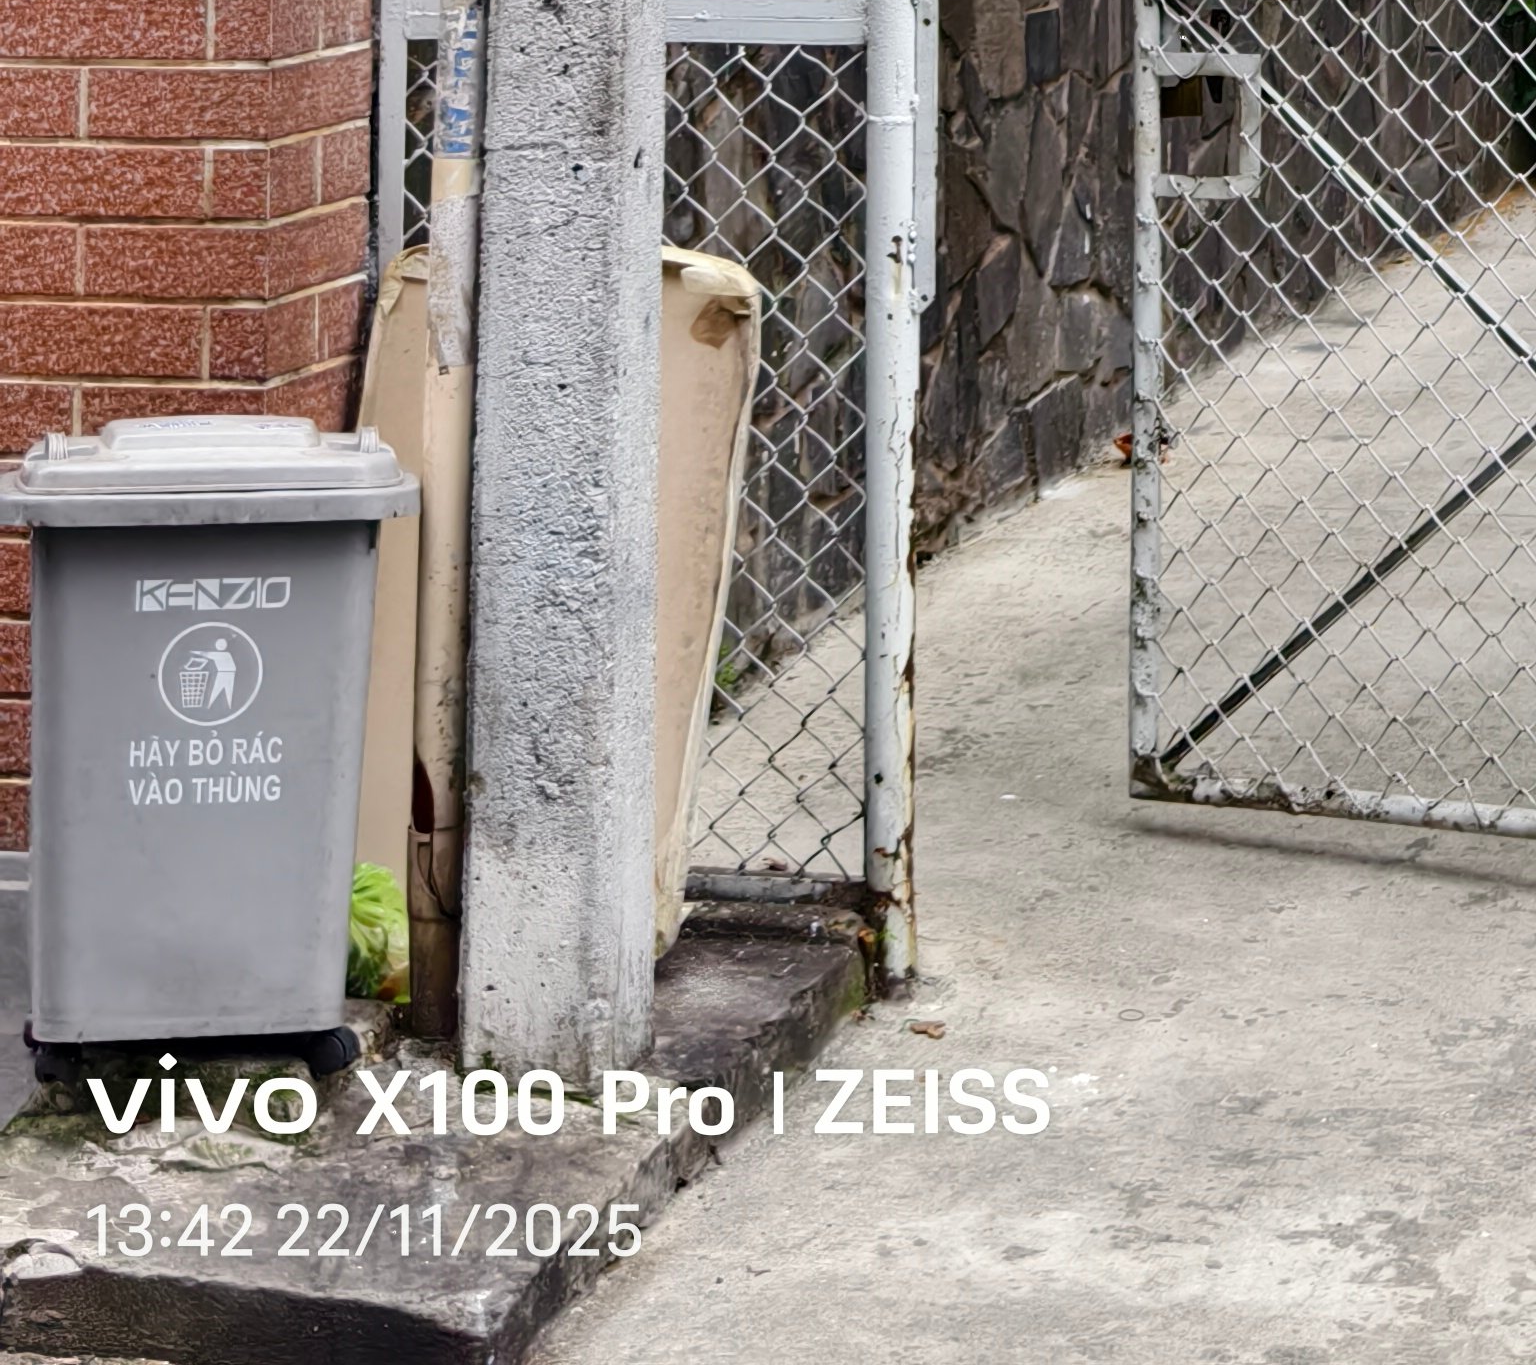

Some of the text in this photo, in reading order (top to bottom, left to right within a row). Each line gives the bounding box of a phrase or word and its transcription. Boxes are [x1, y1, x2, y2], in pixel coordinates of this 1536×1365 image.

[135, 576, 291, 612] KENZIO
[188, 730, 224, 766] BỎ
[231, 731, 283, 765] RÁC
[128, 770, 281, 806] VÀO THÙNG
